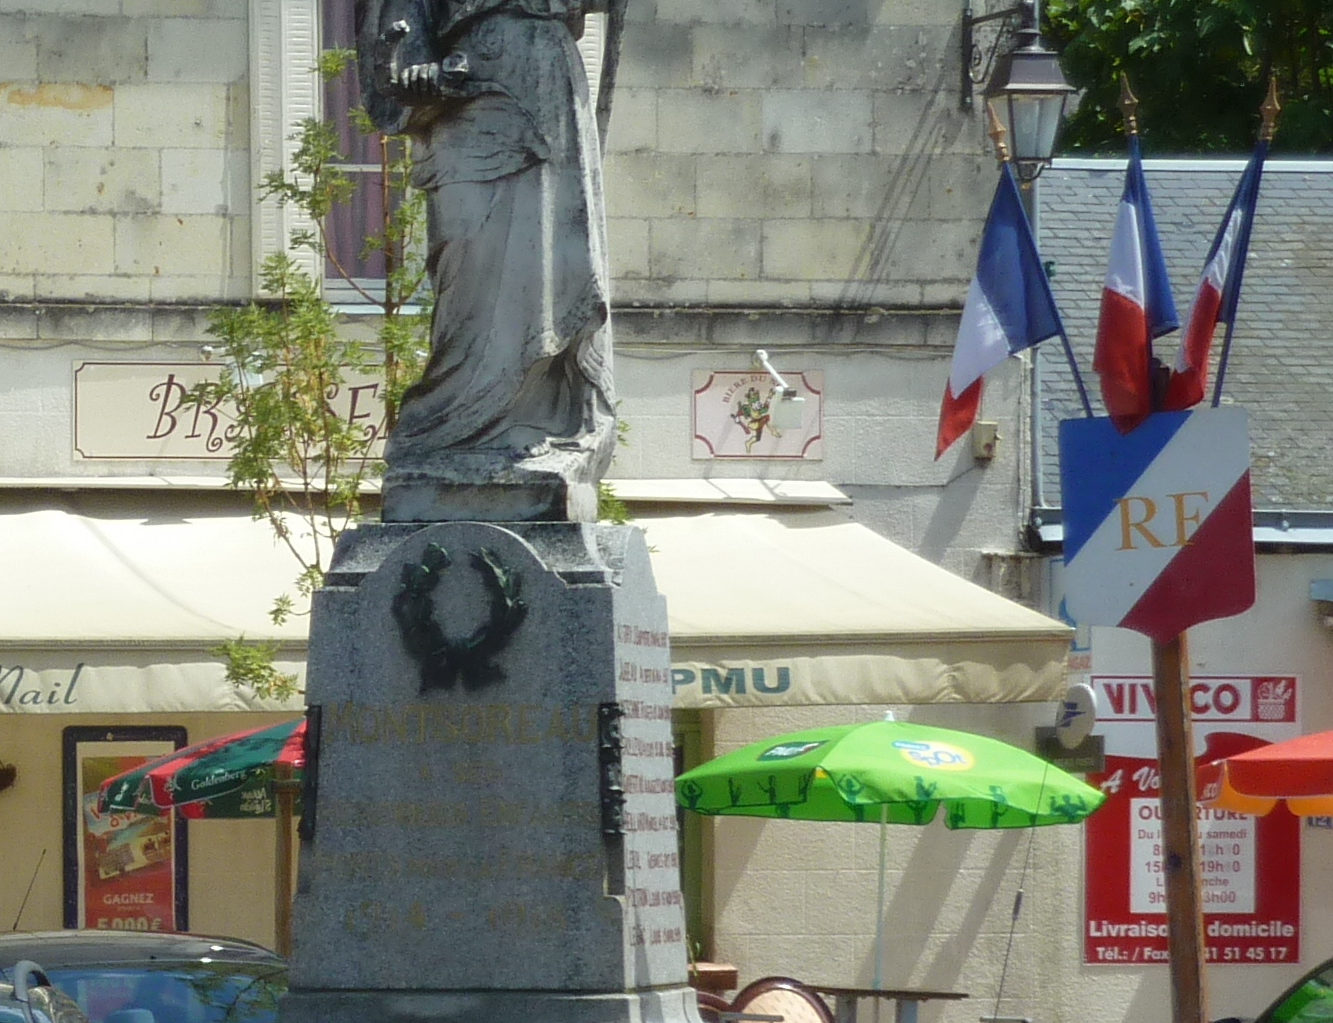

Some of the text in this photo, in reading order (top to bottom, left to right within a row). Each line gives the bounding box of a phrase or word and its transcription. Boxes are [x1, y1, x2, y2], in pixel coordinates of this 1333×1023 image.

[1115, 491, 1209, 550] RF
[671, 667, 791, 695] PMU
[1103, 683, 1241, 714] VIVCO
[191, 768, 247, 790] Goldenberg
[1101, 769, 1123, 792] A
[1138, 828, 1246, 839] Du samedi
[103, 893, 154, 905] GAGNEZ
[1090, 921, 1295, 937] Livraiso domicile
[1223, 947, 1239, 960] 51
[1246, 947, 1264, 960] 45
[1270, 947, 1286, 960] 17
